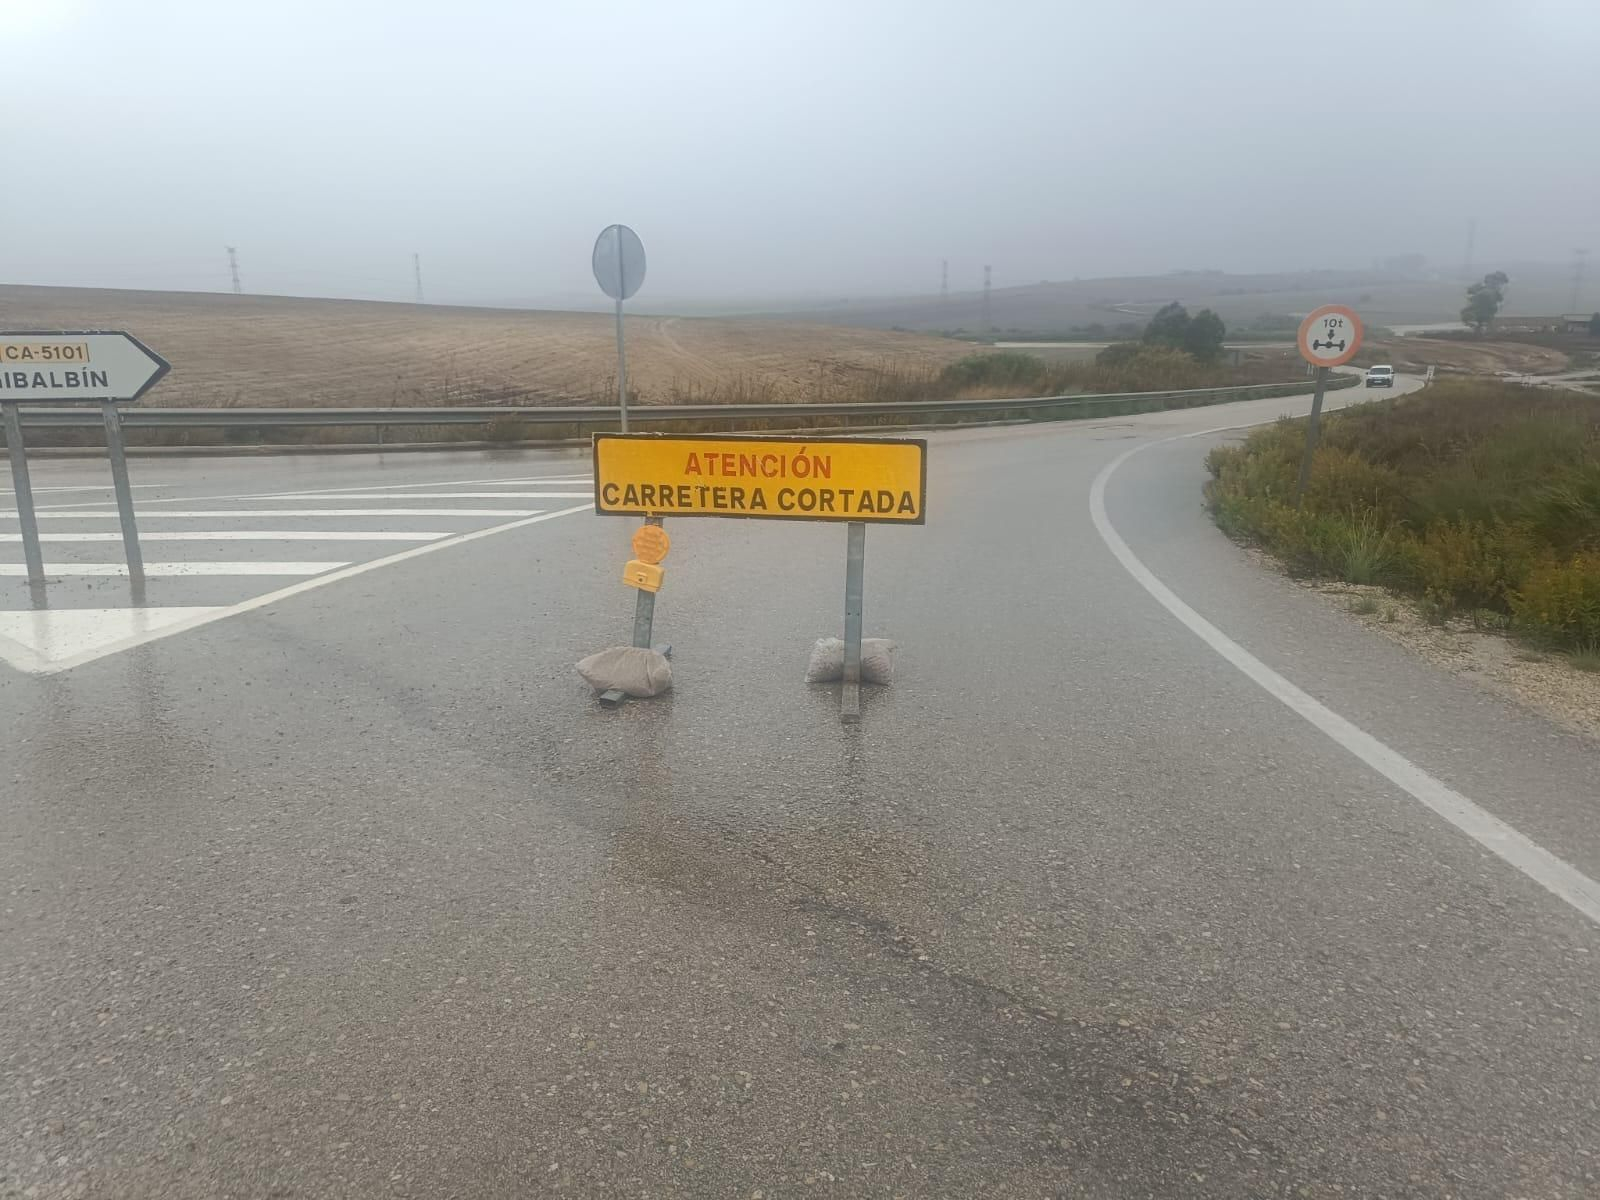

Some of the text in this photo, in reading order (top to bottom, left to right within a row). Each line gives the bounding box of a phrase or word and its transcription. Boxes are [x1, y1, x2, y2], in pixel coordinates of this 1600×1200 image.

[5, 346, 83, 360] CA-5101
[0, 367, 109, 389] IBALBÍN
[684, 446, 831, 479] ATENCIÓN
[602, 482, 916, 514] CARRETERA CORTADA
